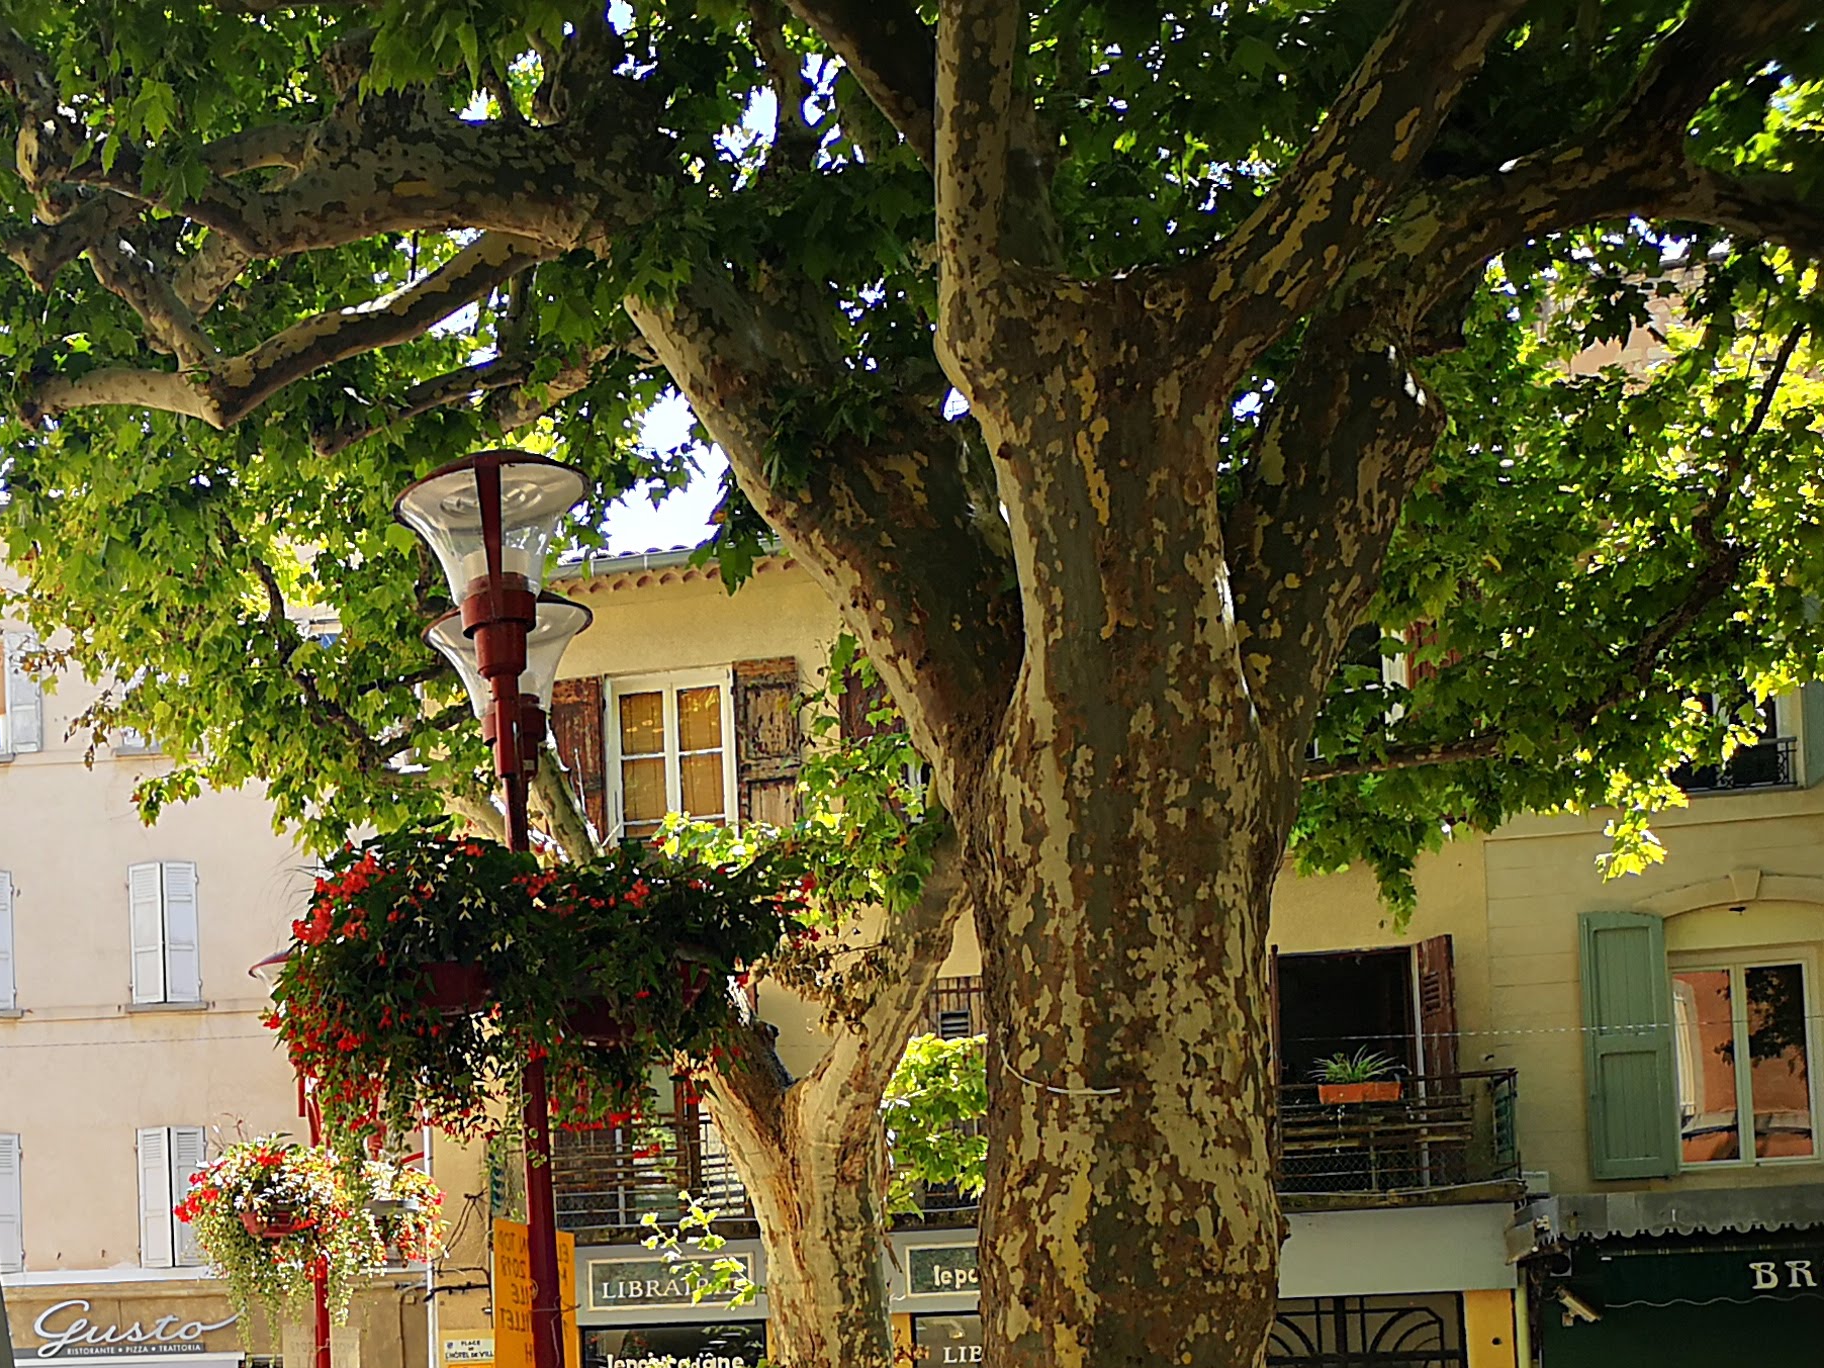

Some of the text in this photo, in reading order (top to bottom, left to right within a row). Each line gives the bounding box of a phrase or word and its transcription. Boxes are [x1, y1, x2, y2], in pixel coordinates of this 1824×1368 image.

[1749, 1260, 1818, 1290] BR
[602, 1278, 739, 1299] LIBRAIRE
[34, 1300, 246, 1358] Gusto
[67, 1343, 201, 1356] RISTORANTE PIZZA TRATTORIA
